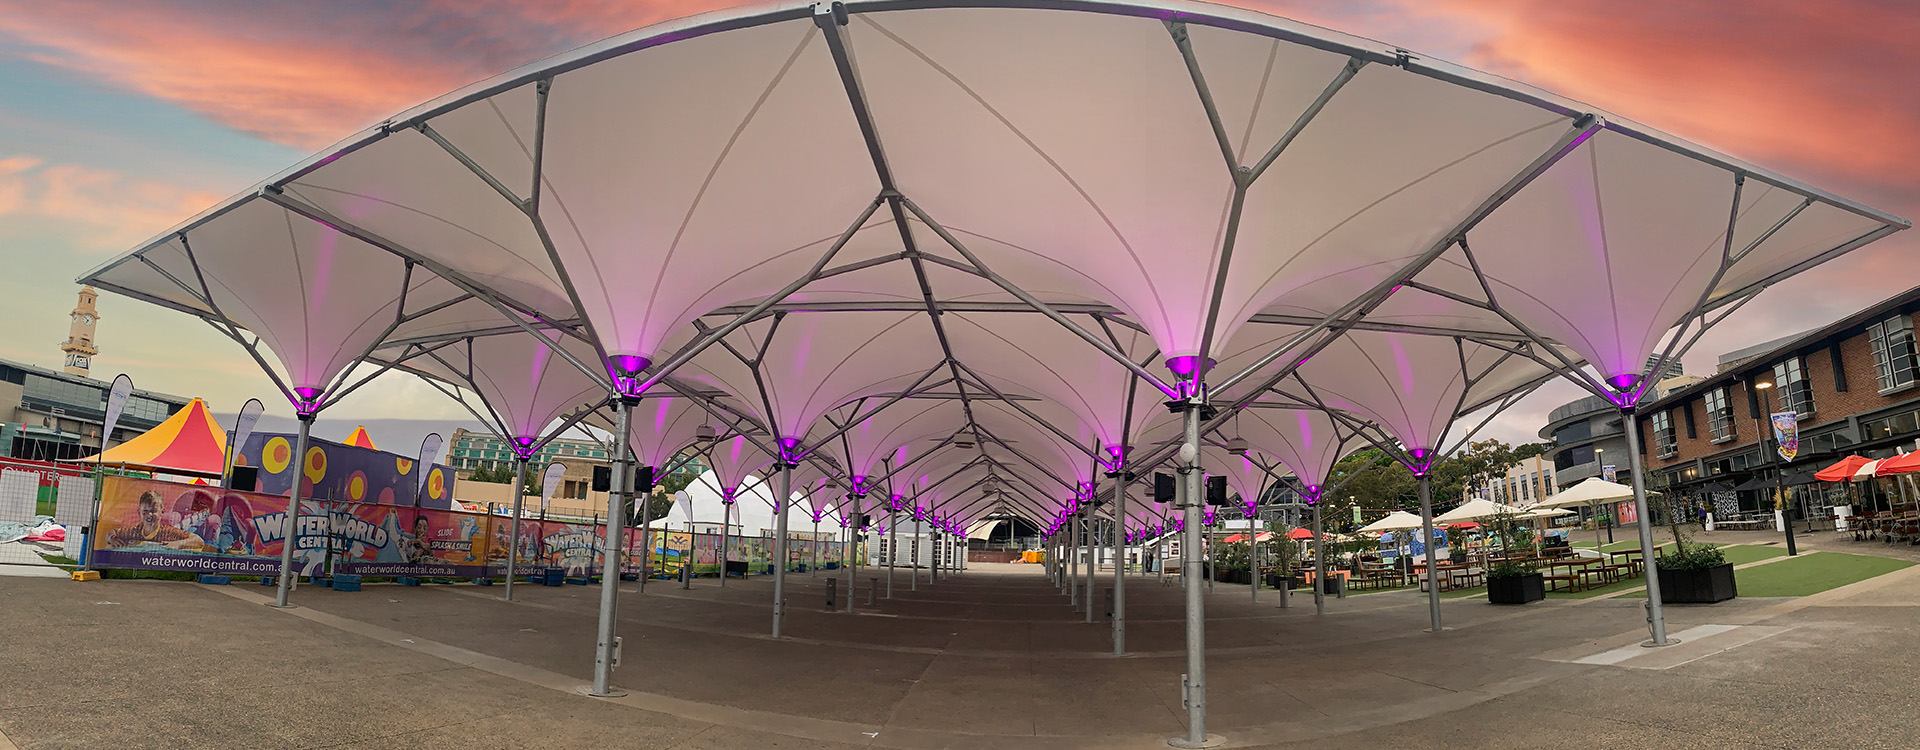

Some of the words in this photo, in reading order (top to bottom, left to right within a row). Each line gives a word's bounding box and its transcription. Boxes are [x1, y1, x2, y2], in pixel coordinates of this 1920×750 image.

[565, 548, 593, 557] CENTRA
[141, 556, 282, 572] waterworldcentral.com.a
[355, 565, 456, 575] waterworldcentral.com.au
